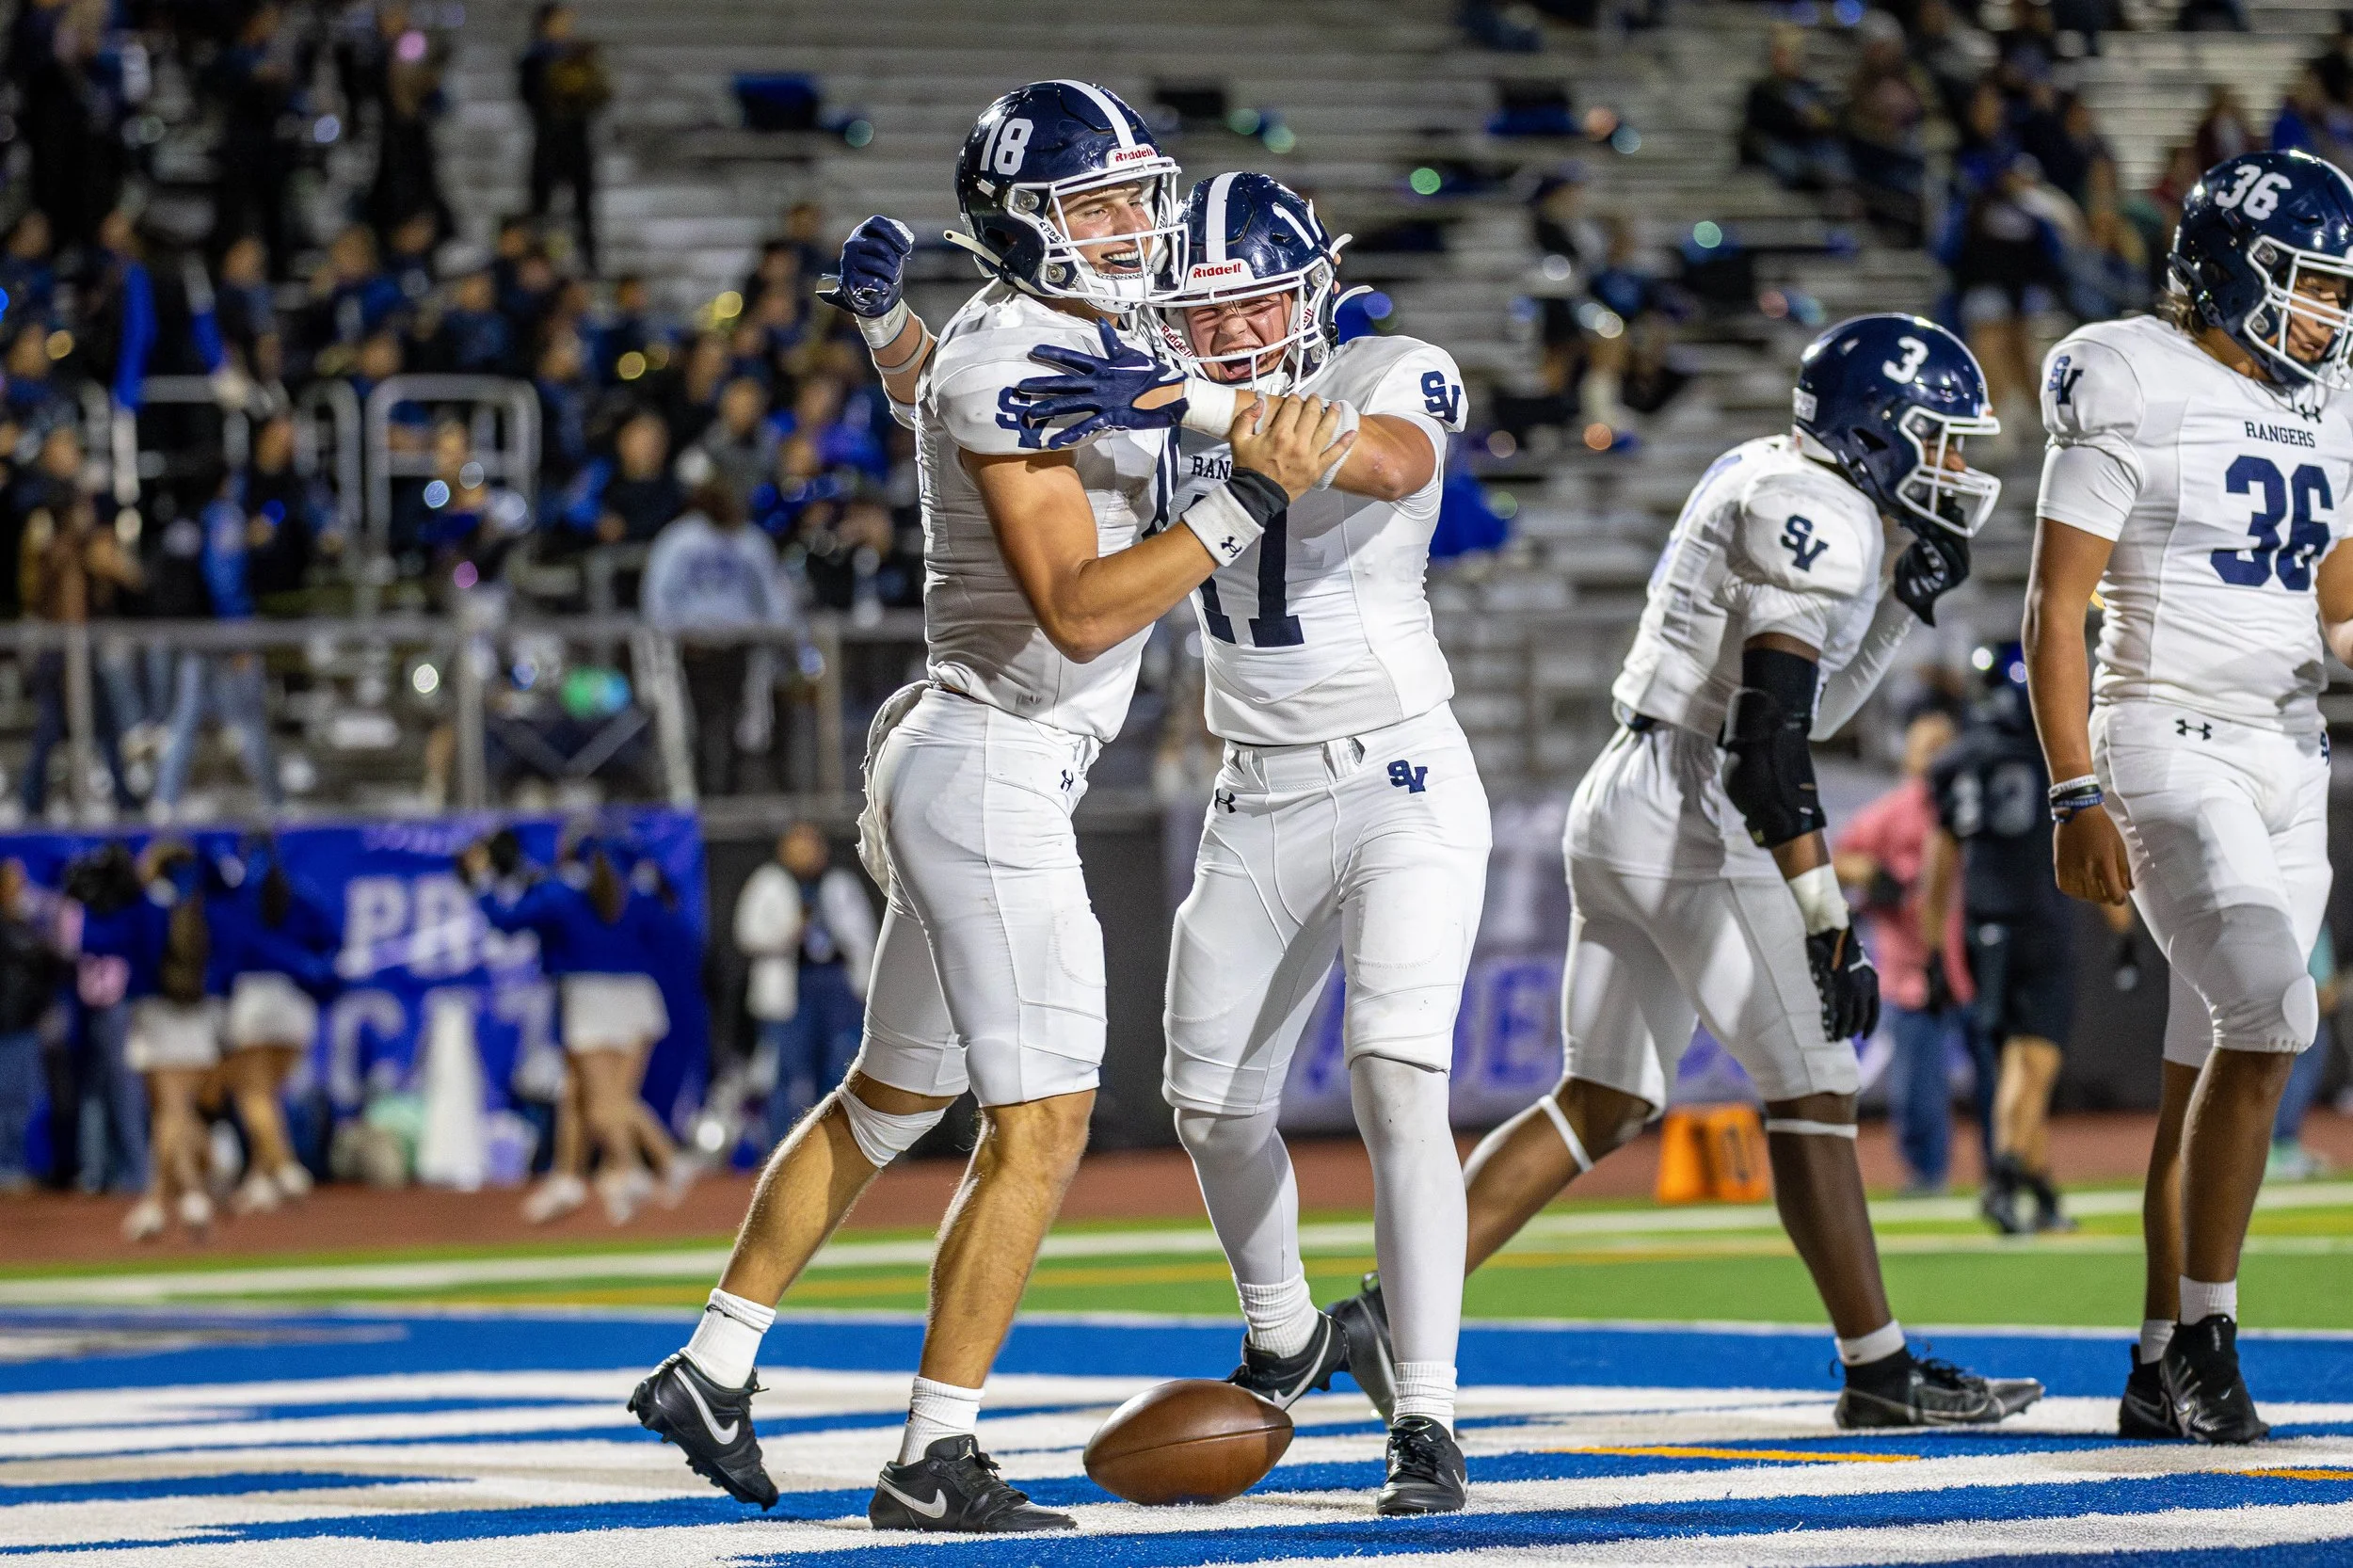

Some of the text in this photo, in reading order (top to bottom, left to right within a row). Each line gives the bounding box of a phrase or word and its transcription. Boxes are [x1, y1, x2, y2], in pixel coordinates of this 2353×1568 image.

[980, 116, 1033, 175] 18
[1115, 147, 1154, 163] Riddell
[2216, 164, 2293, 220] 36
[1193, 263, 1241, 279] Riddell
[1161, 325, 1193, 358] Riddell
[1882, 336, 1929, 384] 3
[1420, 371, 1461, 424] SV
[2246, 421, 2315, 449] RANGERS
[1780, 514, 1829, 573] SV
[2210, 455, 2335, 591] 36
[1386, 759, 1428, 794] SV
